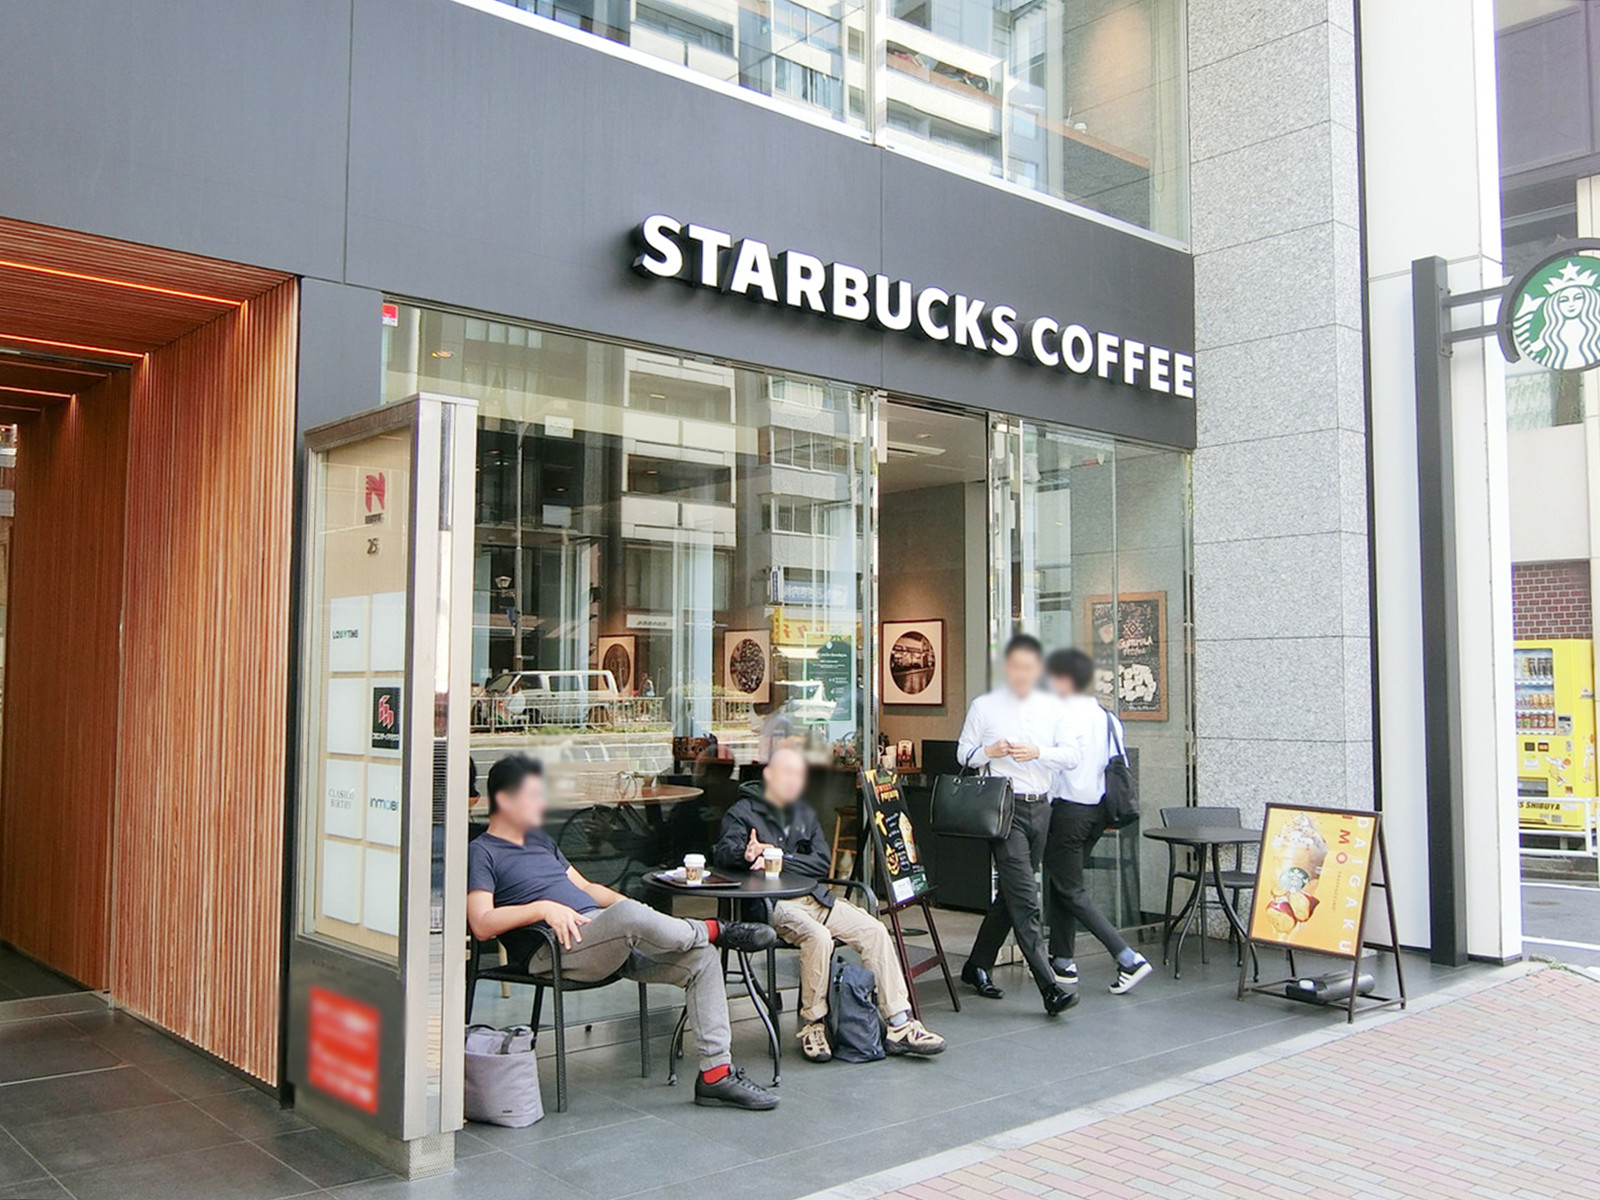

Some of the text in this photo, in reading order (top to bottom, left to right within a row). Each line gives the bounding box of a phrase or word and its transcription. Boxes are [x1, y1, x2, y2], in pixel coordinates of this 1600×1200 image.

[641, 213, 1194, 399] STARBUCKS COFFEE
[1336, 814, 1353, 864] IMO
[1525, 801, 1561, 811] SHIBUYA
[1338, 816, 1370, 953] DAIGAKU
